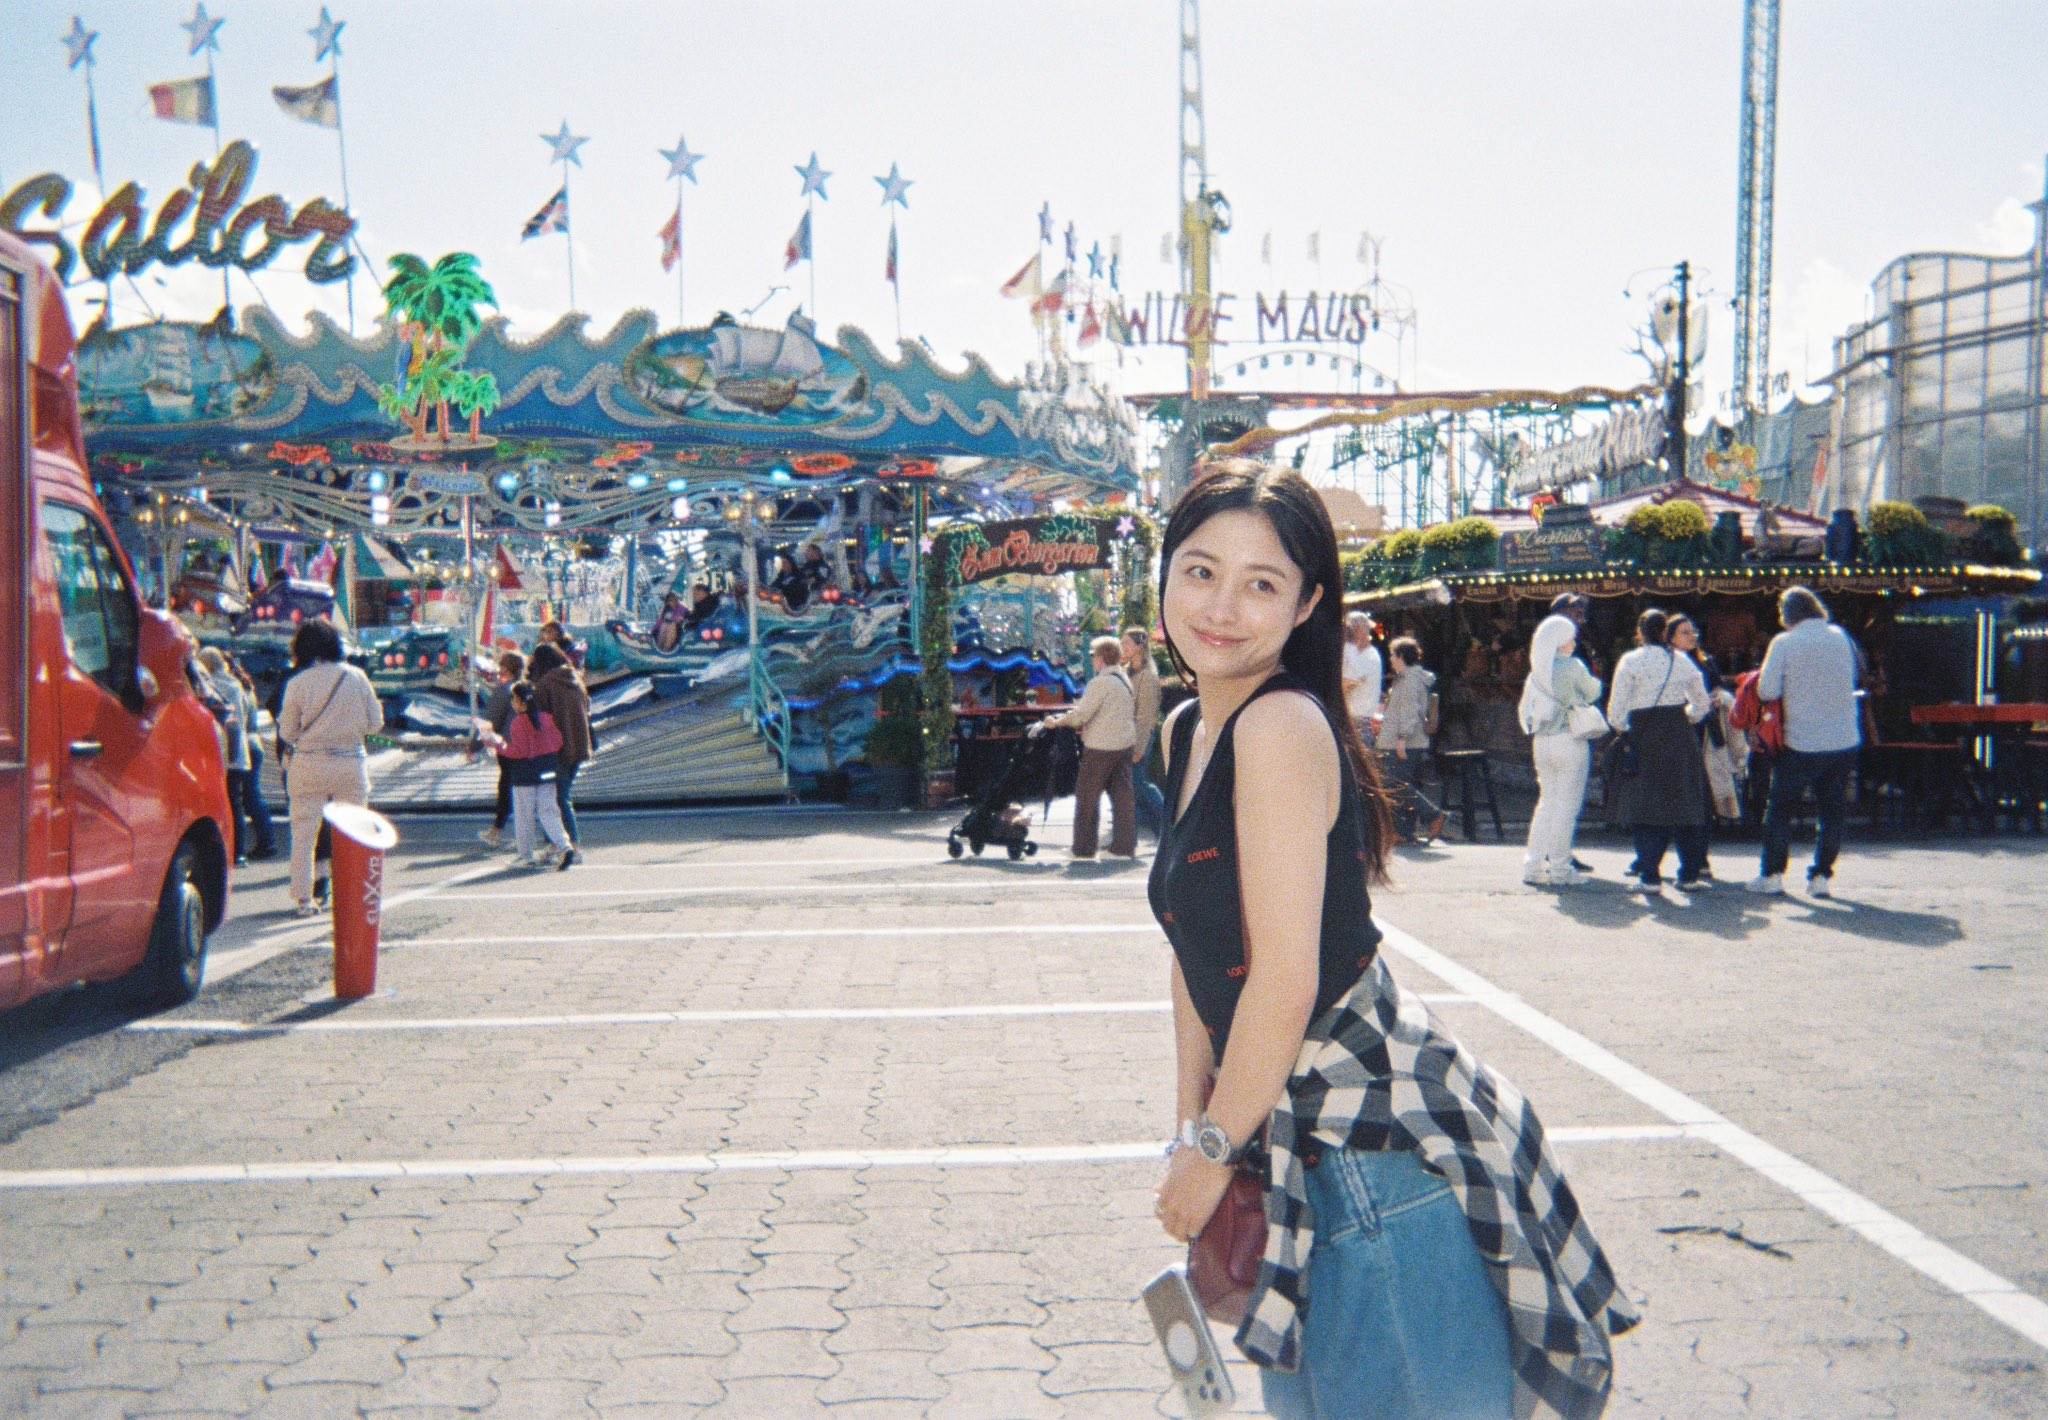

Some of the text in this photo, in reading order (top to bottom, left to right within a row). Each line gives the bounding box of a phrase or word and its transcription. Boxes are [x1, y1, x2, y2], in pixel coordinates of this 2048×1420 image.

[0, 139, 357, 286] Sailor
[1256, 290, 1371, 345] MAUS
[1187, 847, 1220, 864] LOEWE
